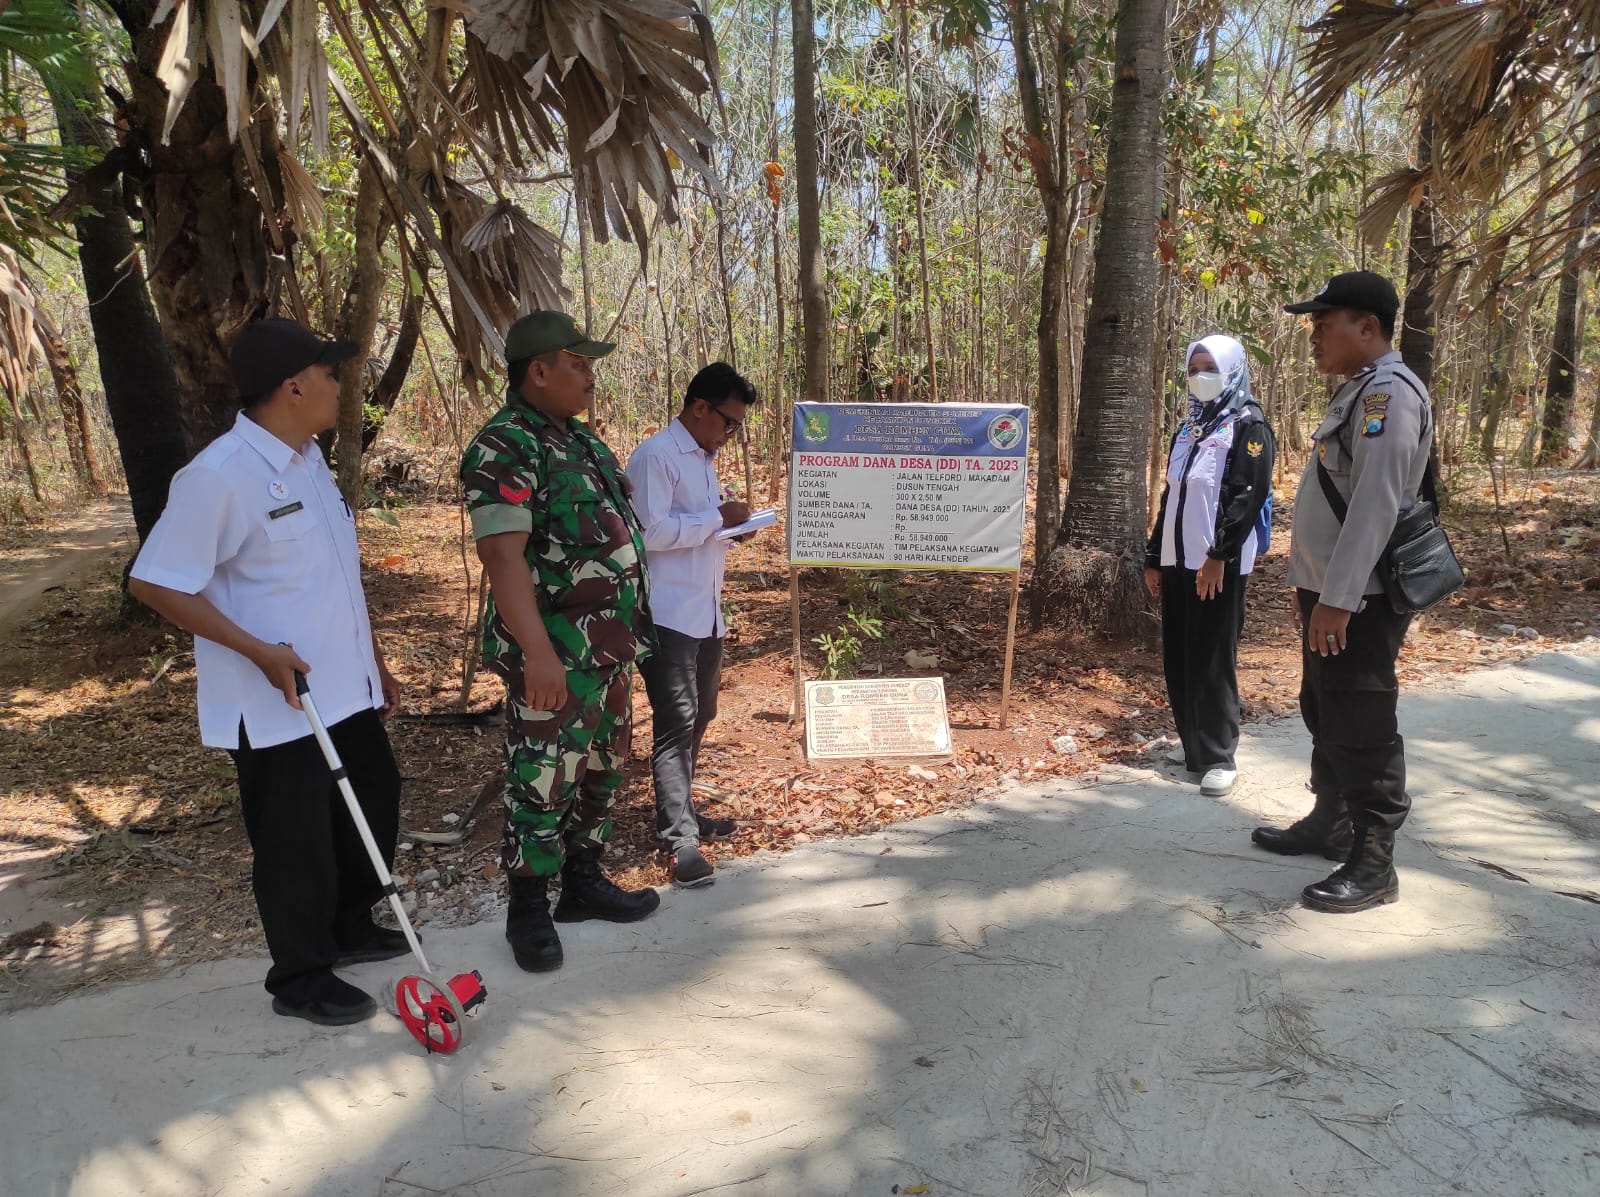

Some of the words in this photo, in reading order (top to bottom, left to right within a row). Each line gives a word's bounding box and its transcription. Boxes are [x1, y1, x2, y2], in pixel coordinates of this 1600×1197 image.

[855, 424, 882, 434] DESA
[886, 425, 931, 435] ROMBEN
[934, 427, 964, 436] GUNA
[799, 455, 859, 468] PROGRAM
[863, 456, 896, 469] DANA
[899, 457, 932, 470] DESA
[936, 458, 961, 472] (DD)
[965, 459, 984, 471] TA.
[988, 459, 1019, 471] 2023
[798, 470, 838, 479] KEGIATAN
[896, 473, 923, 481] JALAN
[926, 473, 962, 482] TELFORD
[968, 474, 1010, 483] MAKADAM
[798, 480, 827, 488] LOKASI
[896, 483, 924, 491] DUSUN
[926, 483, 960, 492] TENGAH
[798, 490, 831, 499] VOLUME
[896, 493, 910, 501] 300
[911, 493, 917, 501] X
[935, 494, 943, 502] M
[798, 500, 831, 509] SUMBER
[832, 501, 855, 509] DANA
[861, 502, 873, 510] TA.
[895, 503, 918, 511] DANA
[920, 503, 942, 512] DESA
[943, 504, 960, 513] (DD)
[962, 505, 989, 513] TAHUN
[797, 510, 819, 518] PAGU
[820, 511, 866, 520] ANGGARAN
[895, 513, 908, 522] Rp.
[910, 514, 949, 522] 58.949.000
[797, 520, 835, 529] SWADAYA
[895, 523, 908, 532] Rp.
[796, 530, 829, 539] JUMLAH
[796, 540, 844, 549] PELAKSANA
[845, 541, 885, 551] KEGIATAN
[894, 543, 908, 551] TIM
[909, 544, 958, 553] PELAKSANA
[959, 545, 1000, 554] KEGIATAN
[796, 550, 824, 558] WAKTU
[826, 551, 885, 560] PELAKSANAAN
[893, 553, 903, 561] 90
[904, 553, 924, 562] HARI
[925, 555, 969, 563] KALENDER
